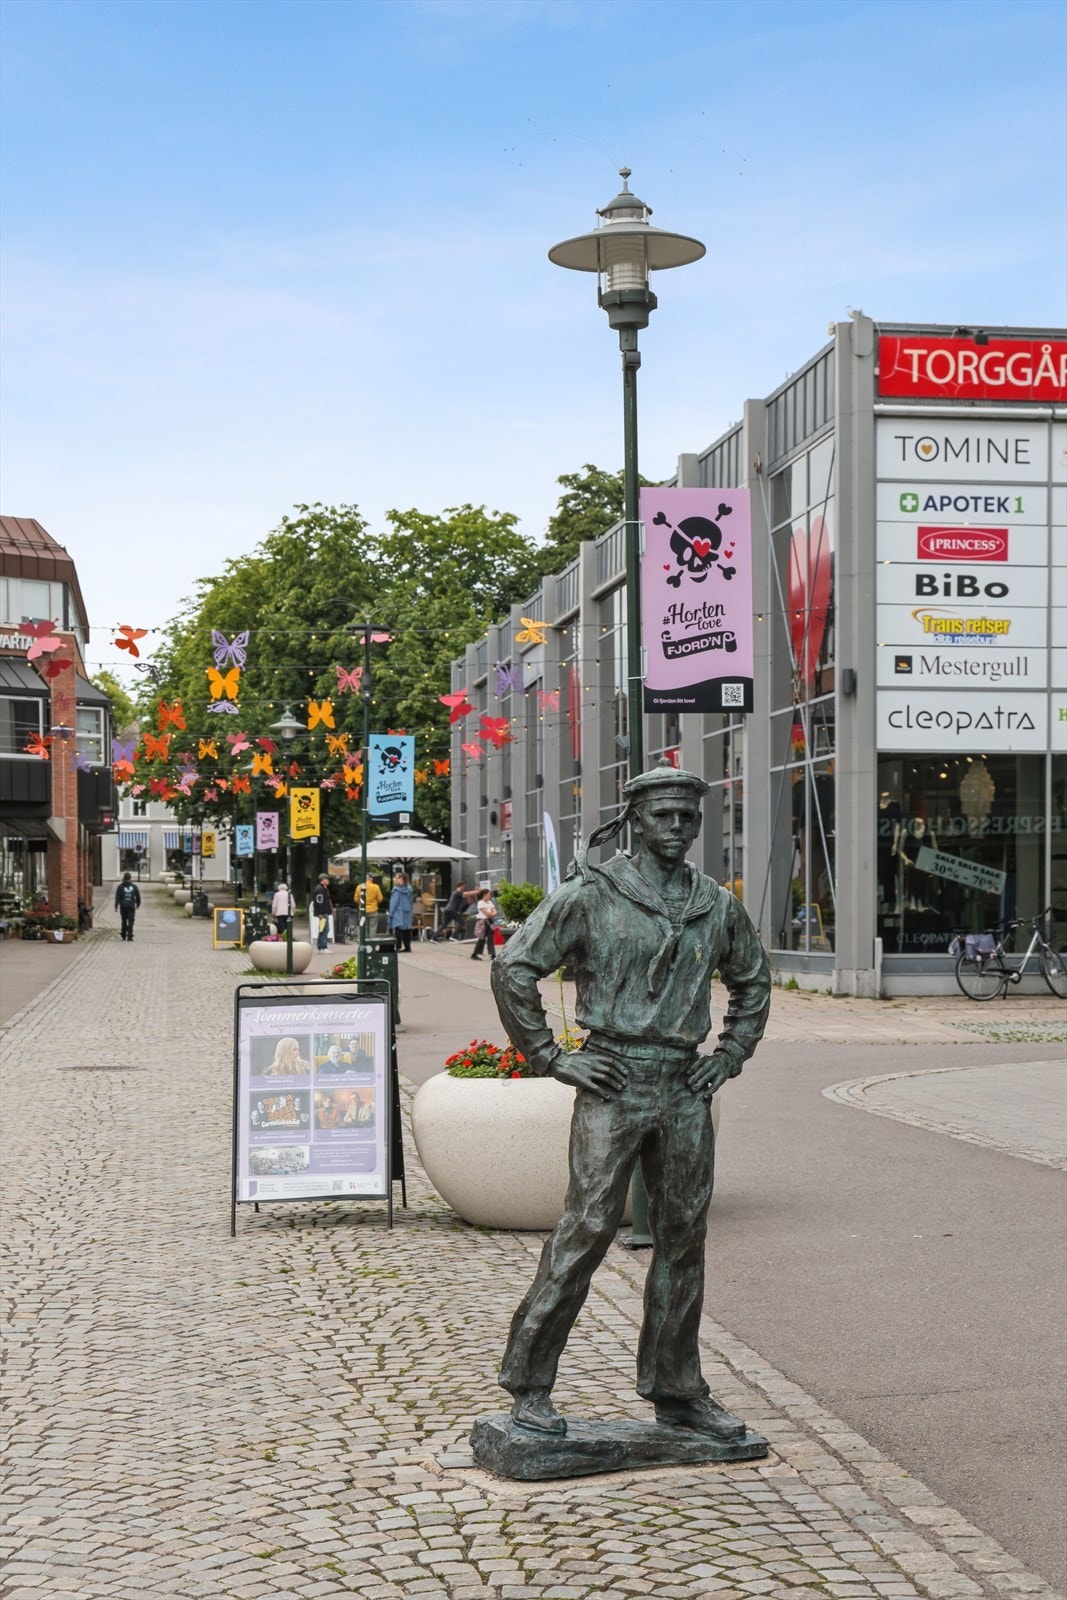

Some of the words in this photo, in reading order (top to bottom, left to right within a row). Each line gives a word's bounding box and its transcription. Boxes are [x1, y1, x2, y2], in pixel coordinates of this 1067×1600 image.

[894, 435, 1031, 465] TOMINE
[922, 495, 1010, 513] APOTEK
[1013, 496, 1025, 514] 1
[935, 538, 997, 551] PRINCESS
[915, 573, 1009, 598] BiBo
[685, 617, 723, 631] love
[922, 614, 965, 634] Trans
[965, 616, 1011, 635] reiser
[0, 633, 39, 650] ARTA
[919, 655, 1029, 682] Mestergull
[888, 704, 1036, 735] cleopatra
[931, 862, 960, 880] 30%
[972, 874, 1000, 892] 70%
[935, 854, 956, 865] SALE
[957, 861, 979, 872] SALE
[980, 868, 1001, 879] SALE
